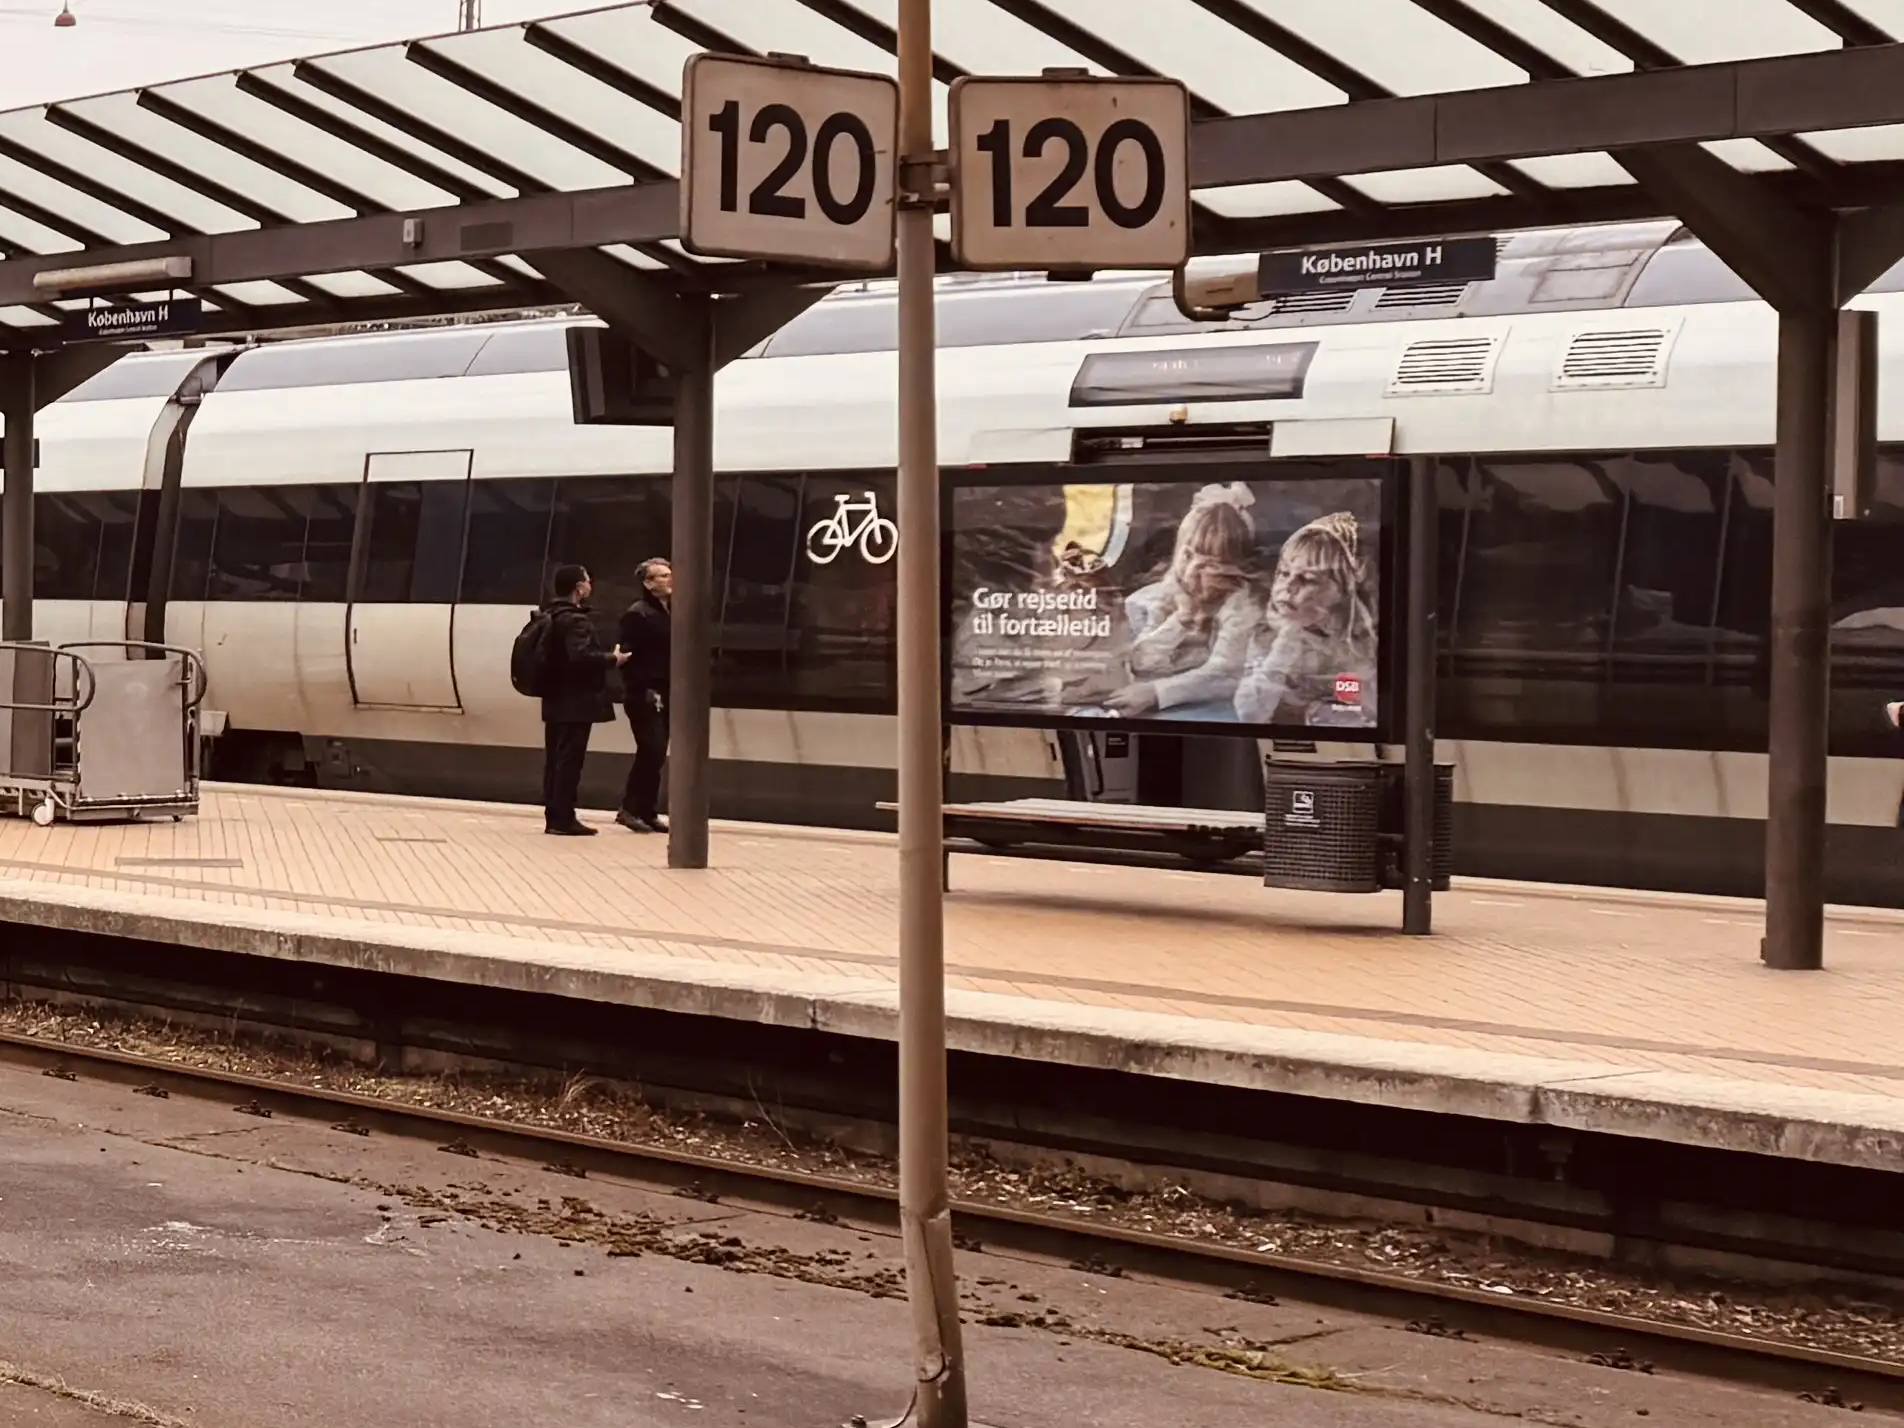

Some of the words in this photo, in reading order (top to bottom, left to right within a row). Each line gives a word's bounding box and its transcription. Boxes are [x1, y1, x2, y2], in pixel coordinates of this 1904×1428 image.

[709, 100, 876, 225] 120
[977, 118, 1166, 229] 120
[1302, 247, 1418, 274] København
[1425, 246, 1442, 266] H
[159, 304, 169, 322] H
[973, 587, 1012, 609] Gør
[1017, 587, 1097, 613] rejsetid
[973, 613, 992, 634] til
[999, 613, 1110, 637] fortælletid
[1336, 680, 1359, 692] DSB
